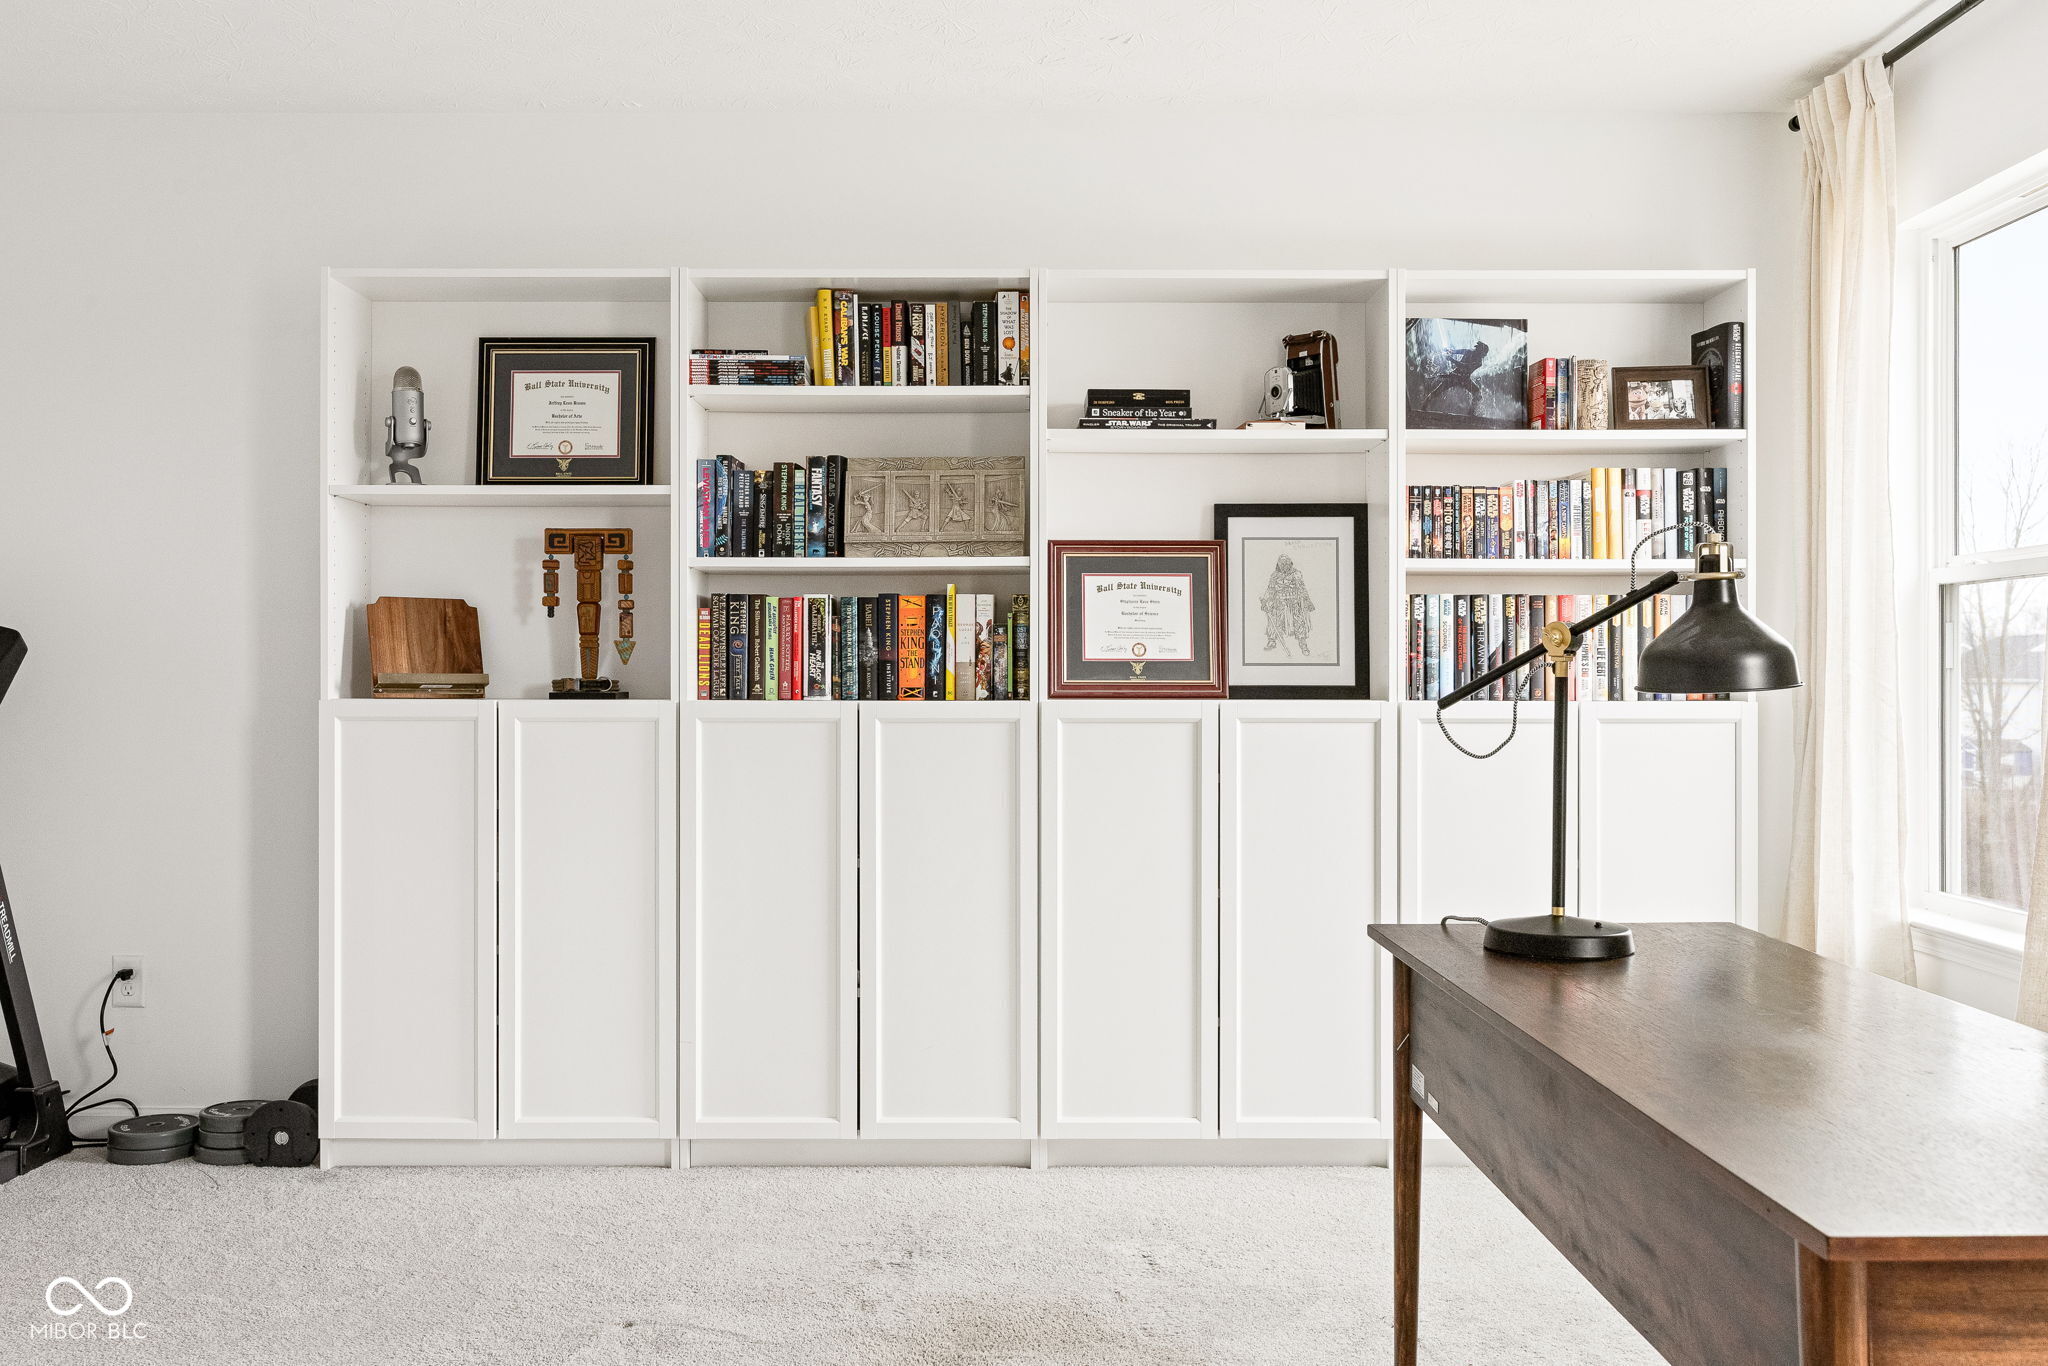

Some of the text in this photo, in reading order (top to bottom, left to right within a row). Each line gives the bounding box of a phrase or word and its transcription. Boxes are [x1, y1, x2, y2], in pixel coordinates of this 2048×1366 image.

[840, 301, 848, 345] CALIBAN'S
[524, 380, 610, 394] Ball State University
[1159, 409, 1176, 417] Year
[812, 468, 822, 506] FANTASY
[702, 468, 711, 548] LEVIATHAN WAKES
[795, 485, 804, 550] REAL TIGERS
[1096, 582, 1182, 596] Ball State University
[730, 602, 739, 634] KING
[1474, 598, 1482, 624] WARS
[713, 630, 720, 640] OF
[900, 637, 925, 649] KING
[1477, 625, 1485, 665] THRAWN
[699, 623, 710, 686] DEAD LIONS
[900, 658, 925, 669] STAND
[1596, 648, 1606, 677] LIFE DEBT
[0, 901, 16, 964] TREADMILL
